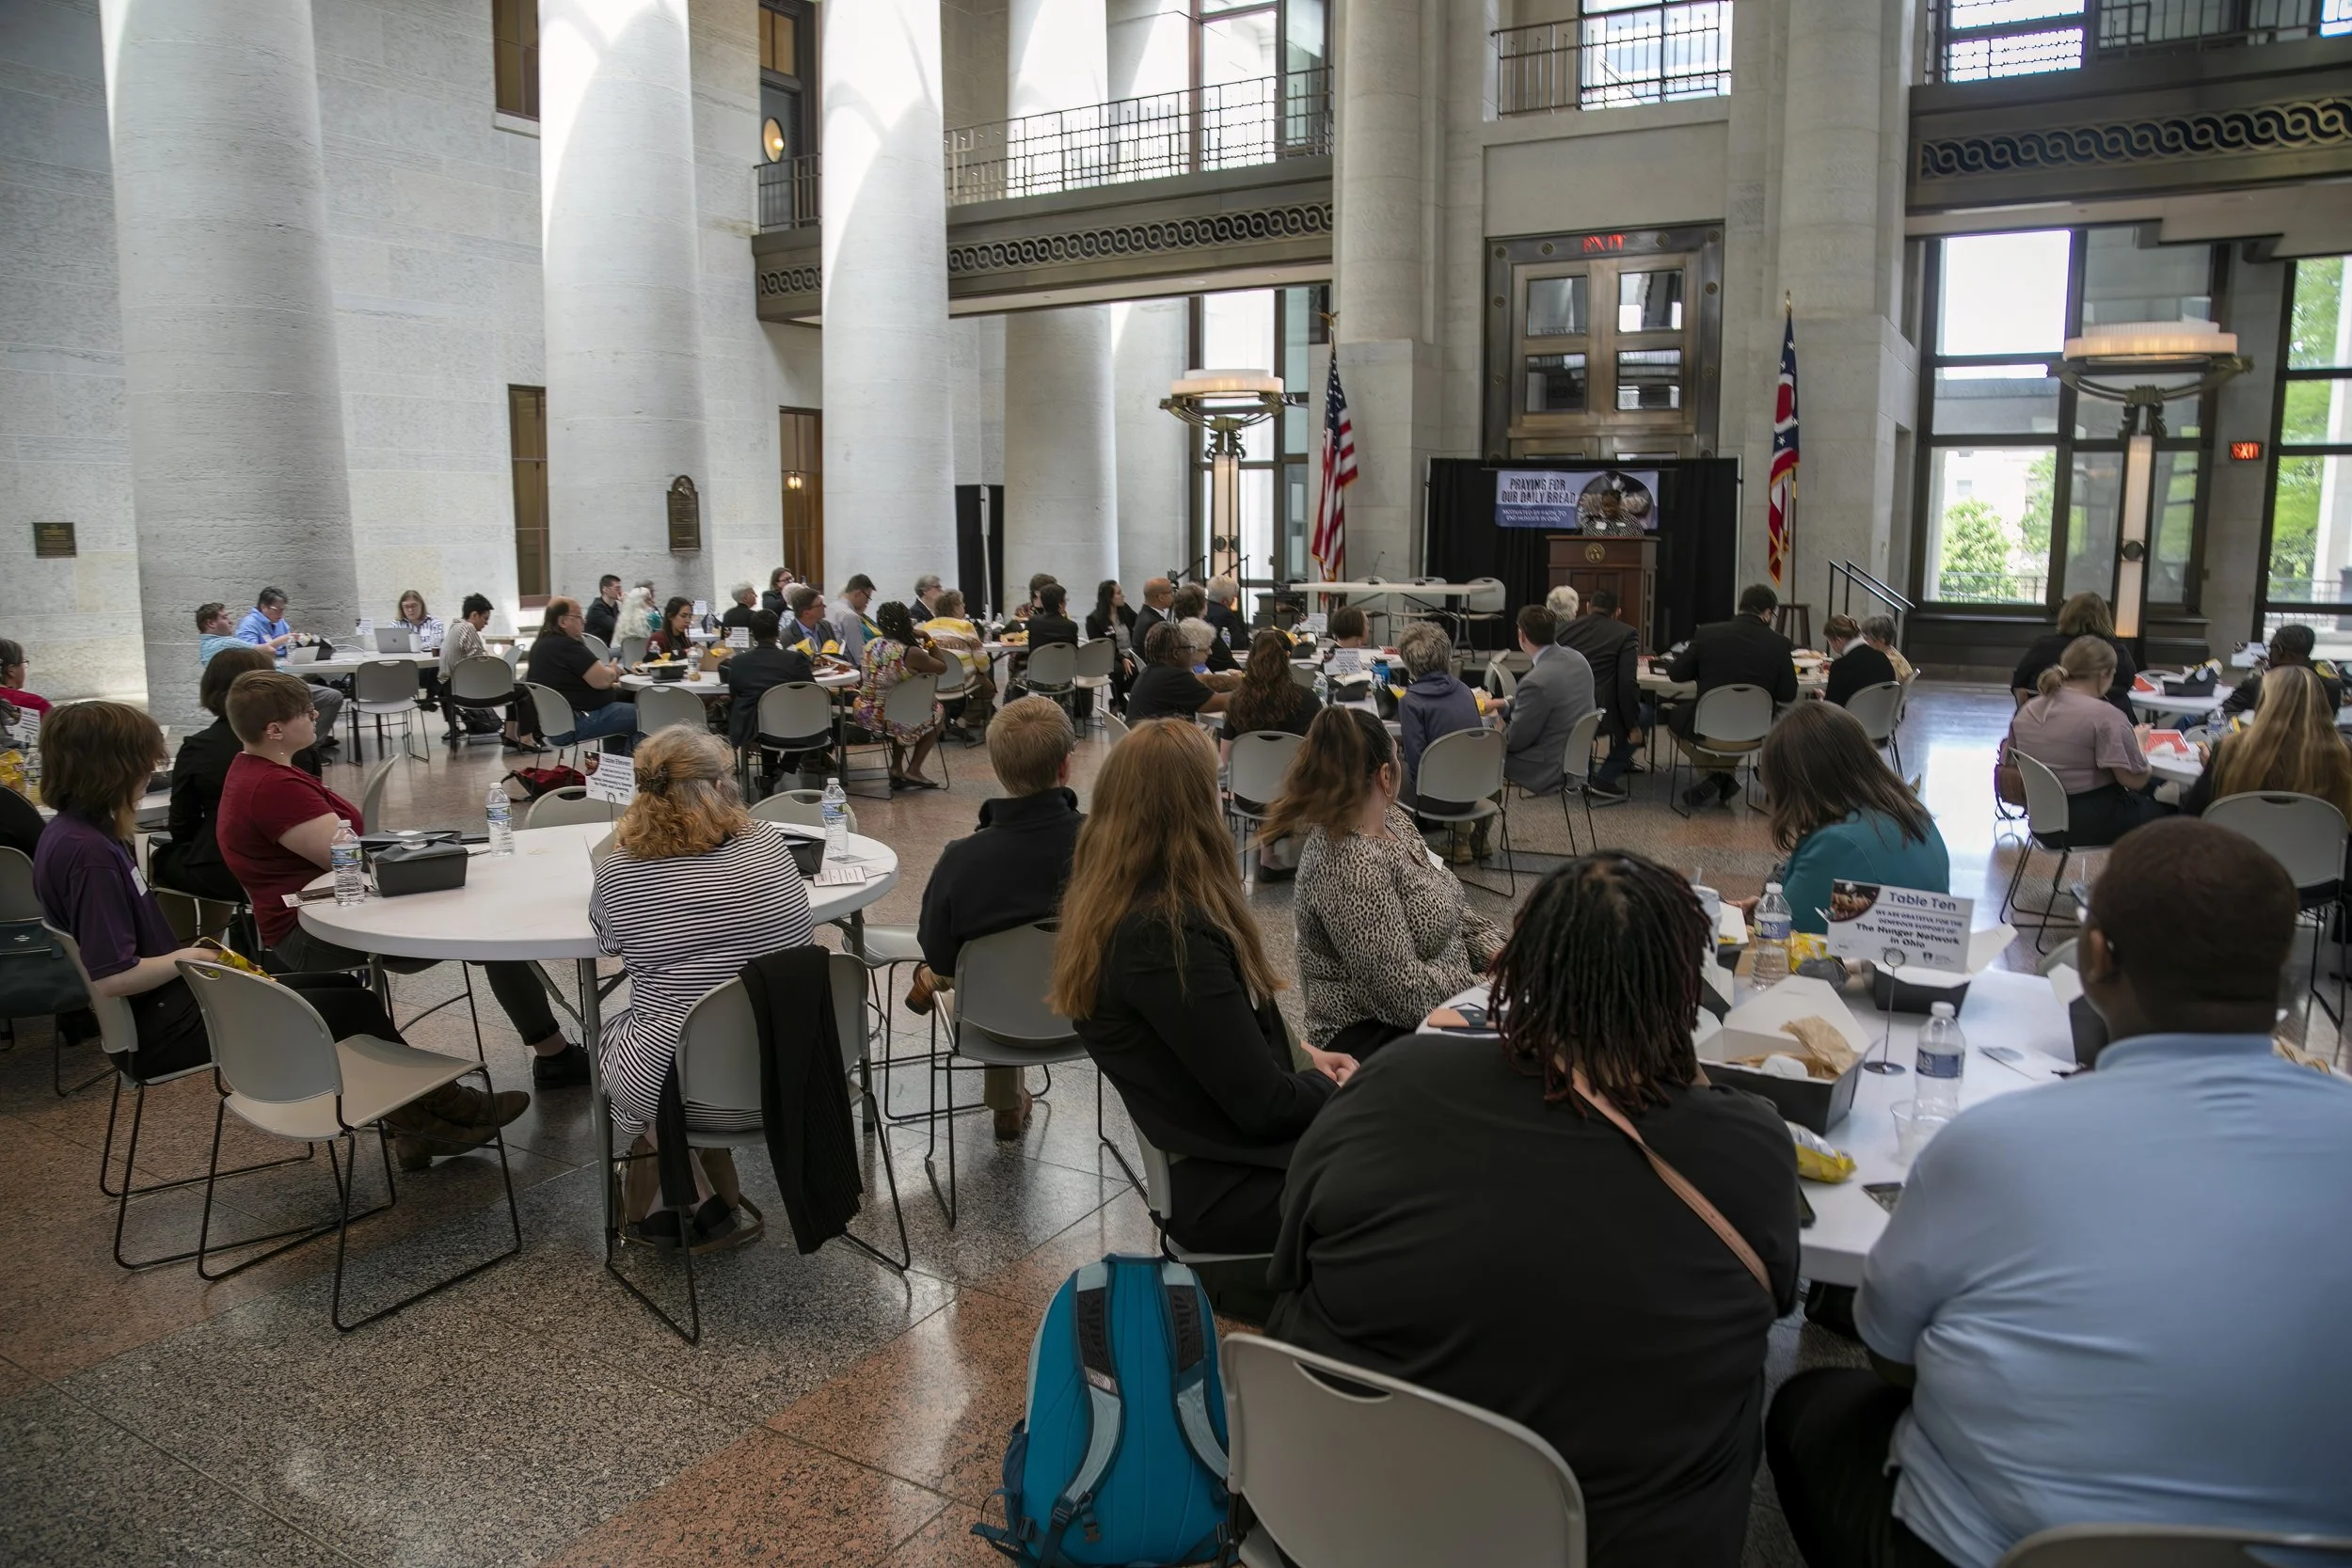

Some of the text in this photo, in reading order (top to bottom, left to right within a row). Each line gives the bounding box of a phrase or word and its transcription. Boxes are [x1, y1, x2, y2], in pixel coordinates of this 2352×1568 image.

[2233, 442, 2259, 459] EXIT
[1510, 478, 1566, 491] PRAYING FOR
[1502, 491, 1576, 504] OUR DAILY BREAD
[1889, 892, 1957, 911] Table Ten
[1879, 918, 1913, 927] GENEROUS
[1915, 924, 1945, 932] SUPPORT
[1901, 912, 1934, 923] GRATEFUL
[1950, 919, 1963, 927] THE
[1855, 923, 1960, 945] The Hunger Network
[1890, 936, 1926, 948] in Ohio
